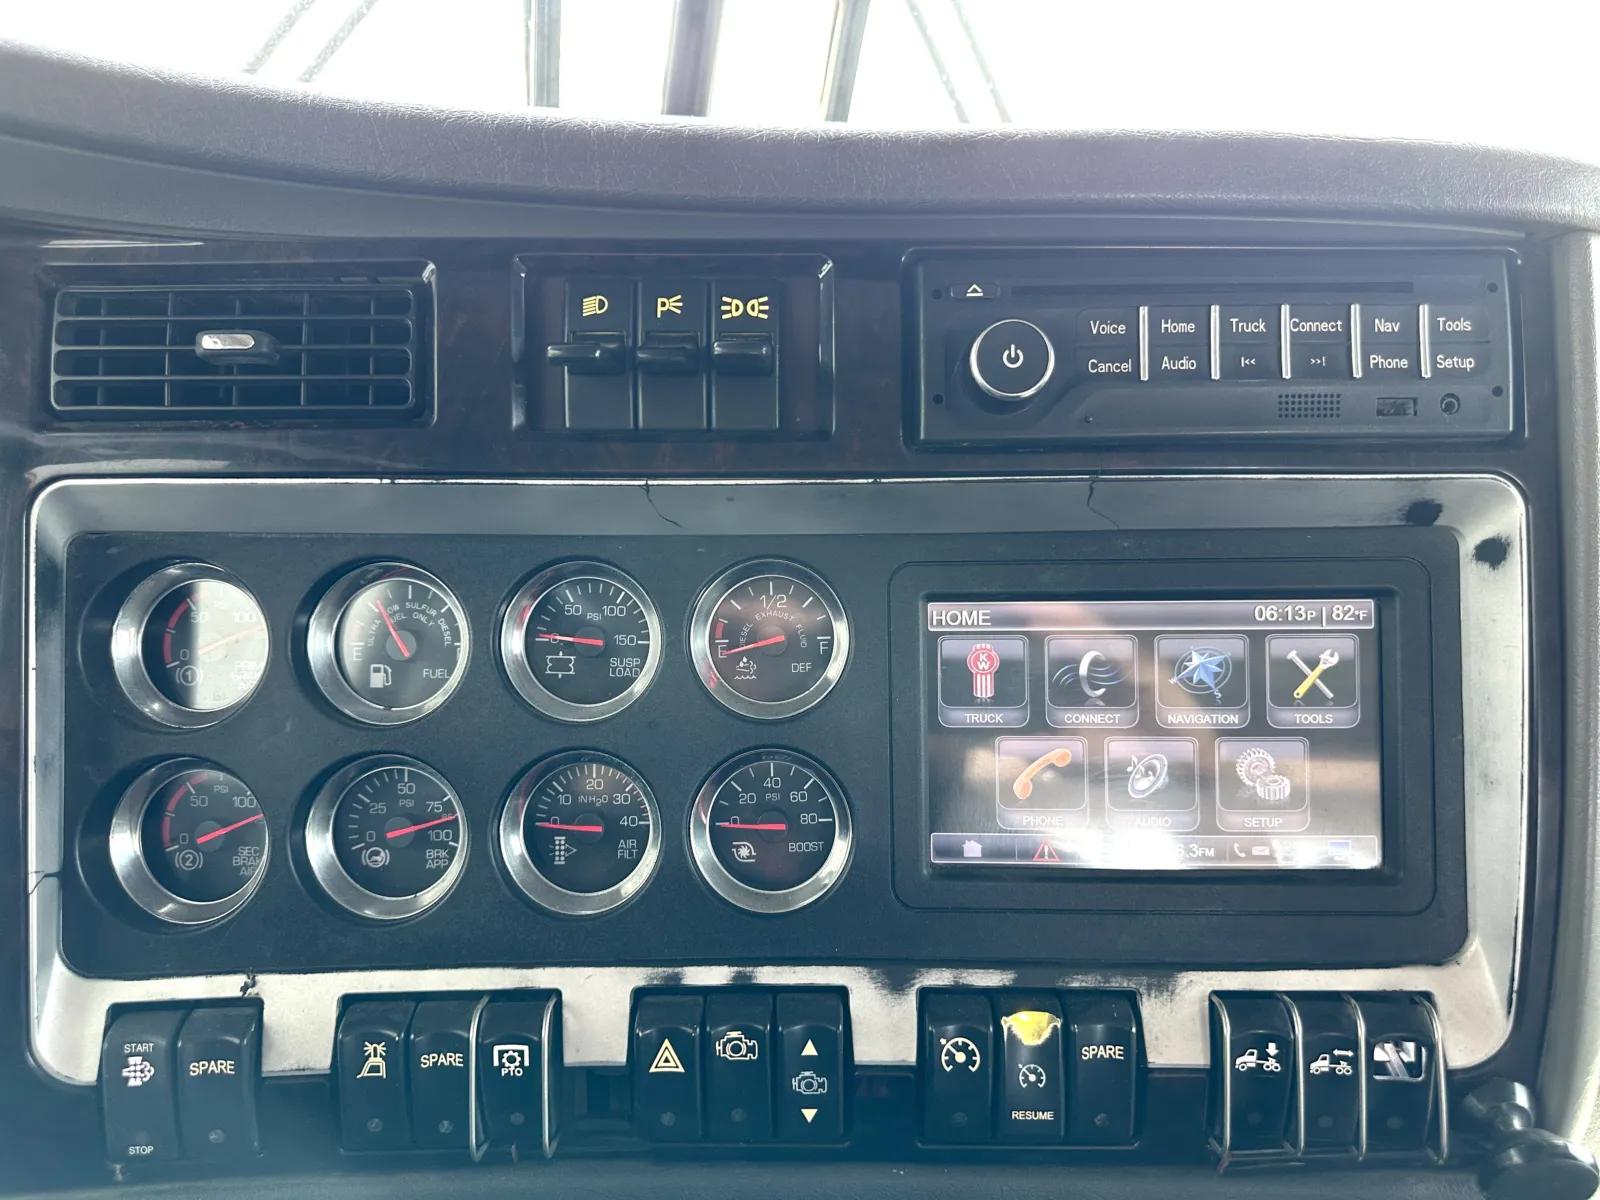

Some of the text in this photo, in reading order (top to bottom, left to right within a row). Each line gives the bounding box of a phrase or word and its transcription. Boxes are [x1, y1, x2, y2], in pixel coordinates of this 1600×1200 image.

[1090, 320, 1126, 335] Voice
[1161, 319, 1195, 333] Home
[1230, 318, 1266, 333] Truck
[1290, 318, 1342, 332] Connect
[1374, 318, 1400, 333] Nav
[1437, 317, 1472, 332] Tools
[1088, 358, 1132, 373] Cancel
[1161, 356, 1197, 370] Audio
[1370, 355, 1408, 368] Phone
[1436, 355, 1475, 371] Setup
[760, 594, 788, 609] 1/2
[564, 604, 582, 616] 50
[602, 605, 627, 617] 100
[754, 610, 796, 622] EXHAUST
[412, 611, 435, 627] ONLY
[586, 612, 602, 621] PSI
[932, 609, 992, 626] HOME
[405, 601, 438, 617] SULFUR
[437, 618, 452, 647] DIESEL
[613, 635, 637, 646] 150
[352, 647, 363, 661] E
[819, 641, 829, 655] F
[180, 649, 189, 660] 0
[609, 657, 641, 667] SUSP
[791, 662, 812, 673] DEF
[423, 668, 450, 679] FUEL
[609, 667, 641, 678] LOAD
[965, 713, 1004, 724] TRUCK
[1064, 713, 1121, 724] CONNECT
[1167, 713, 1239, 725] NAVIGATION
[1294, 713, 1333, 724] TOOLS
[213, 784, 229, 793] PSI
[397, 783, 416, 795] 50
[586, 778, 604, 790] 20
[763, 777, 782, 789] 40
[190, 796, 208, 807] 50
[232, 796, 257, 808] 100
[557, 794, 572, 805] 10
[612, 793, 631, 805] 30
[738, 793, 757, 805] 20
[765, 792, 780, 801] PSI
[789, 791, 808, 803] 60
[369, 802, 387, 814] 25
[399, 799, 415, 808] PSI
[425, 801, 443, 813] 75
[619, 815, 638, 827] 40
[799, 813, 818, 825] 80
[1022, 815, 1065, 826] PHONE
[1135, 816, 1172, 827] AUDIO
[1243, 817, 1283, 828] SETUP
[179, 833, 189, 844] 0
[366, 831, 376, 842] 0
[427, 829, 453, 841] 100
[617, 839, 637, 849] AIR
[788, 841, 825, 853] BOOST
[238, 846, 260, 857] SEC
[425, 849, 449, 859] BRK
[617, 849, 638, 859] FILT
[425, 859, 449, 869] APP
[124, 1043, 155, 1053] START
[1081, 1045, 1125, 1060] SPARE
[420, 1053, 464, 1068] SPARE
[189, 1060, 236, 1077] SPARE
[501, 1067, 524, 1076] PTO
[1011, 1110, 1055, 1121] RESUME
[128, 1146, 154, 1155] STOP
